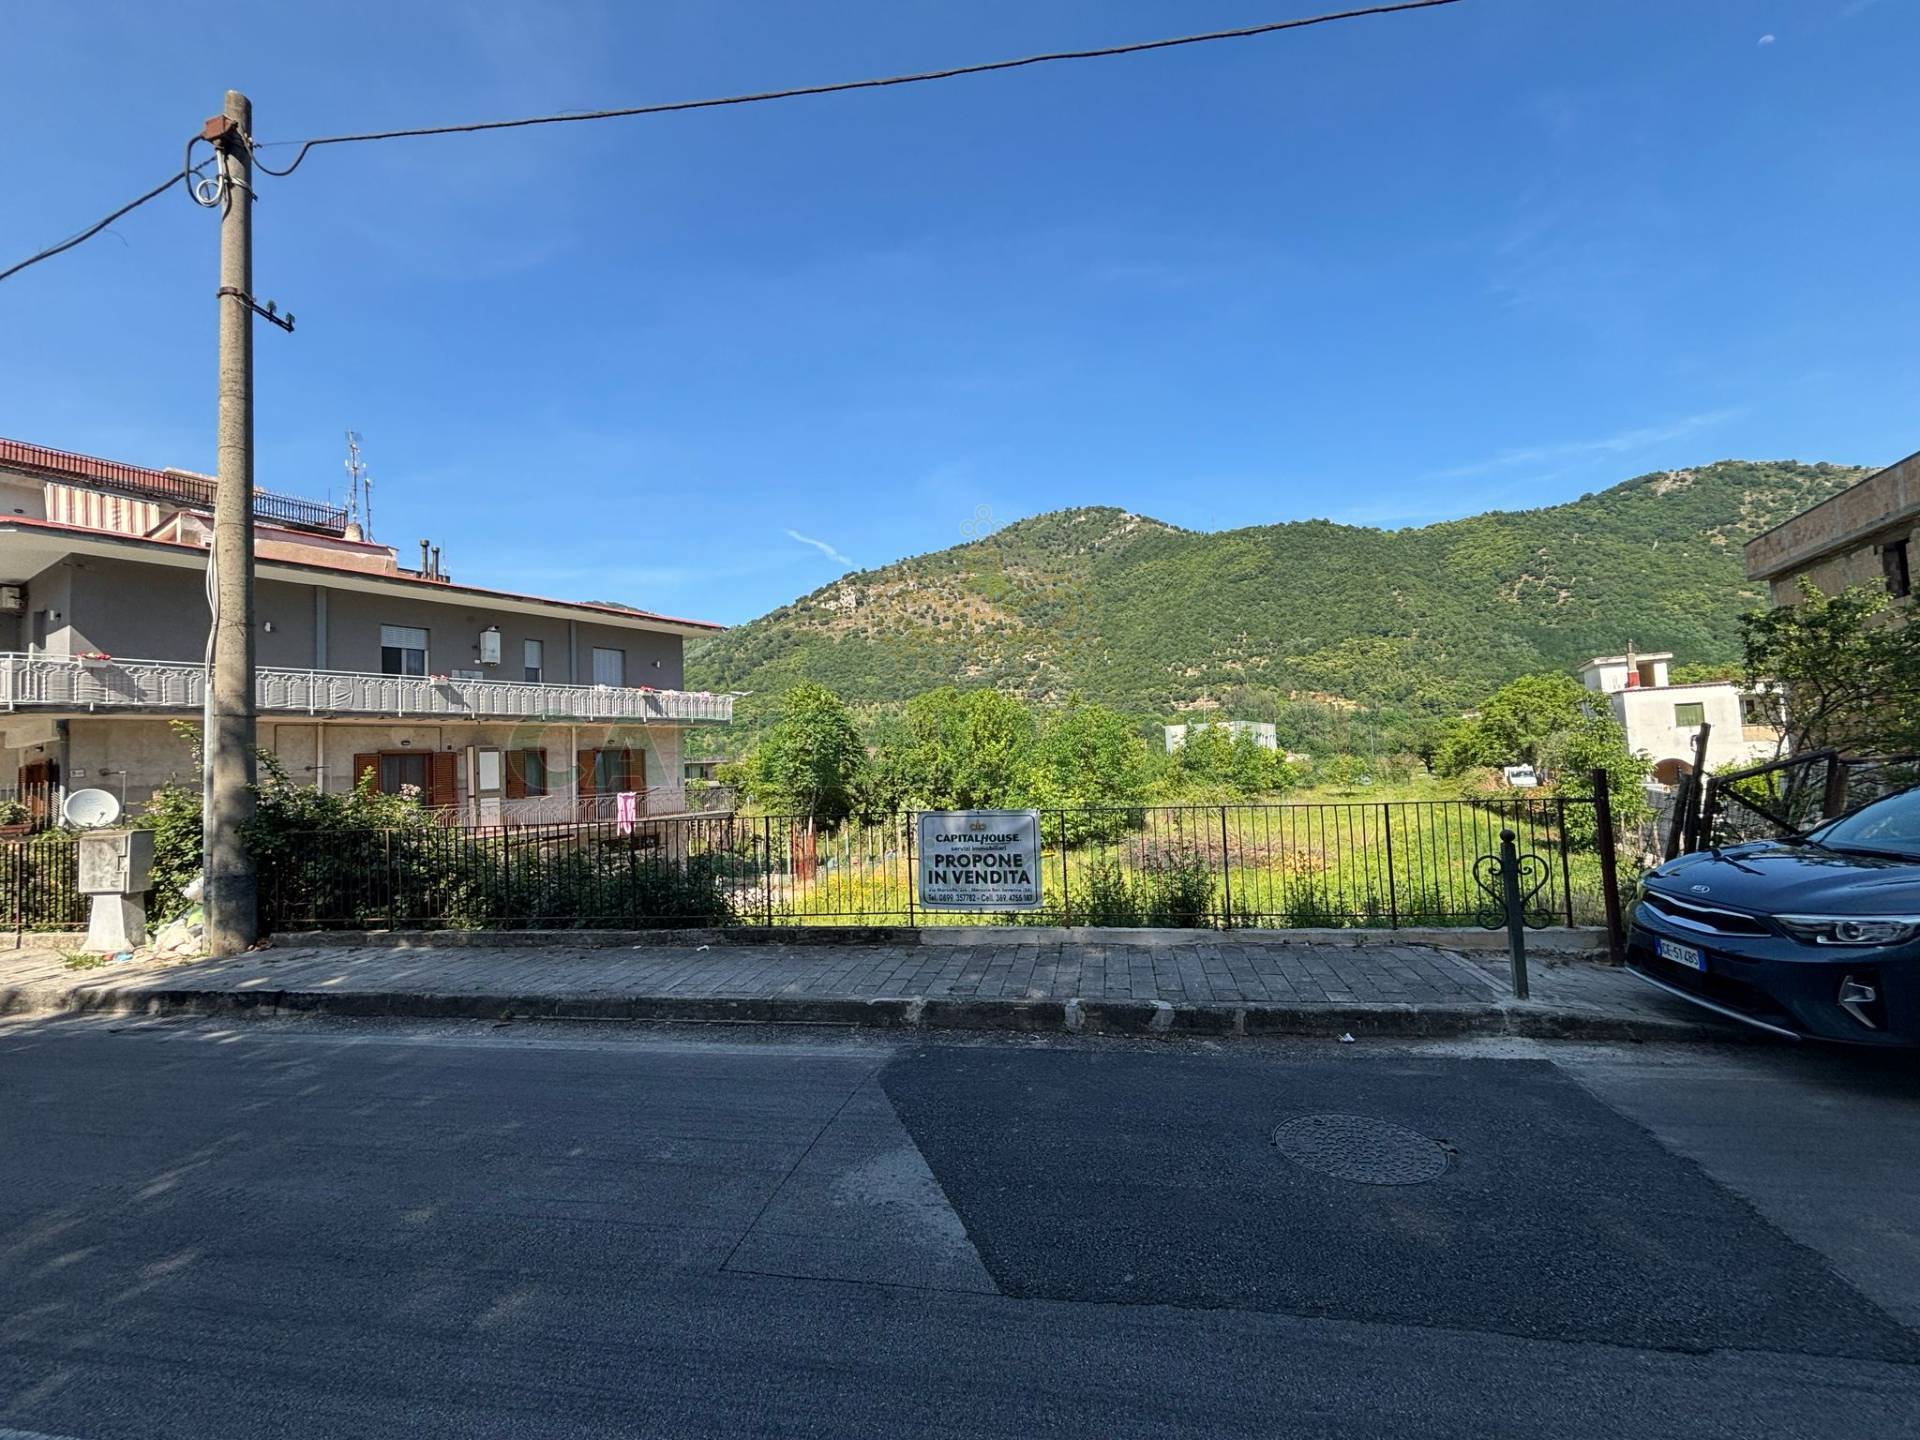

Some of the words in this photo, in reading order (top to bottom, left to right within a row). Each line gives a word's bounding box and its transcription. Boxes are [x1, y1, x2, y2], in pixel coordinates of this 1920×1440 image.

[935, 833, 1020, 844] CAPITALHOUSE
[935, 853, 1023, 868] PROPONE
[928, 870, 947, 884] IN
[952, 869, 1031, 884] VENDITA
